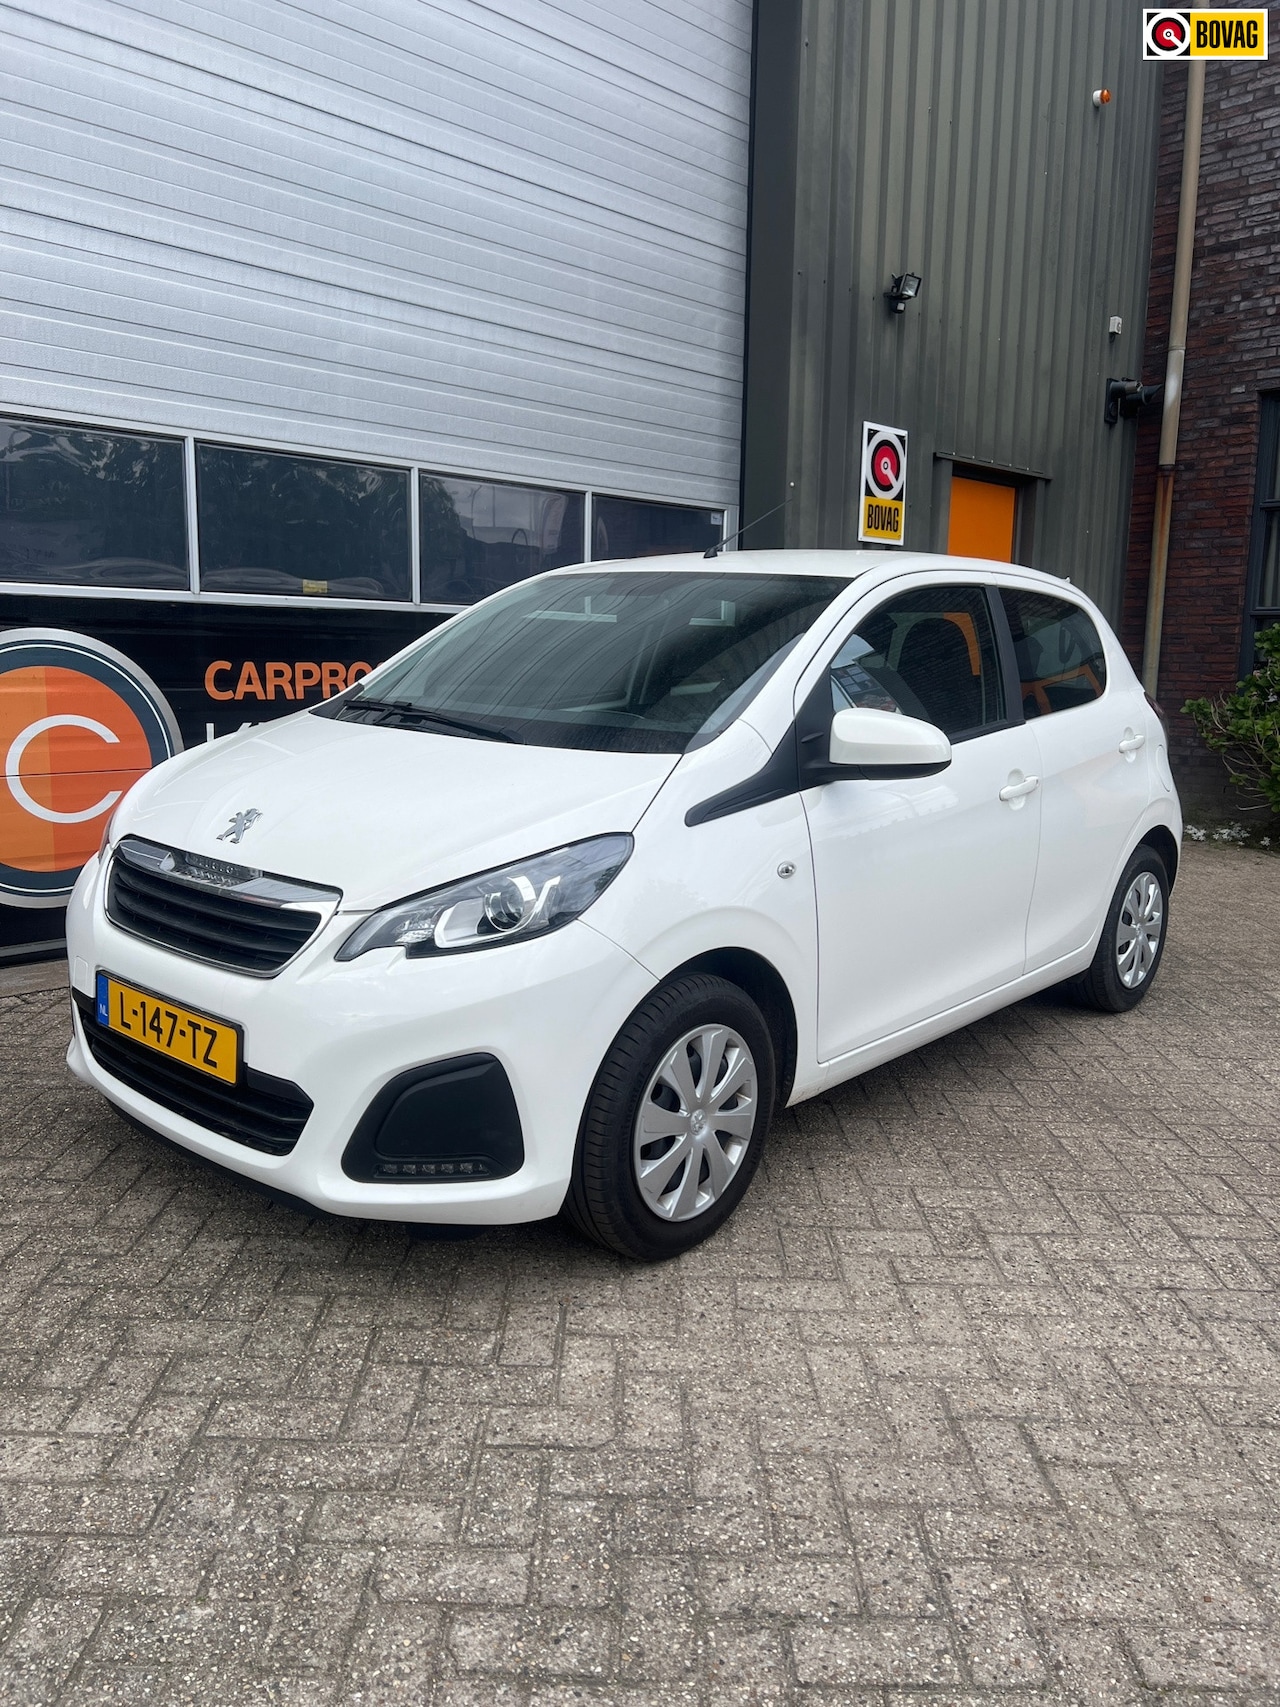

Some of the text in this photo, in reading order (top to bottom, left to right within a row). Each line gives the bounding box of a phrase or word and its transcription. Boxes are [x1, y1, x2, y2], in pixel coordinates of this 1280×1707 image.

[867, 504, 899, 532] BOVAG
[204, 660, 384, 700] CARPRO
[99, 1004, 108, 1017] NL
[120, 991, 218, 1069] L-147-TZ
